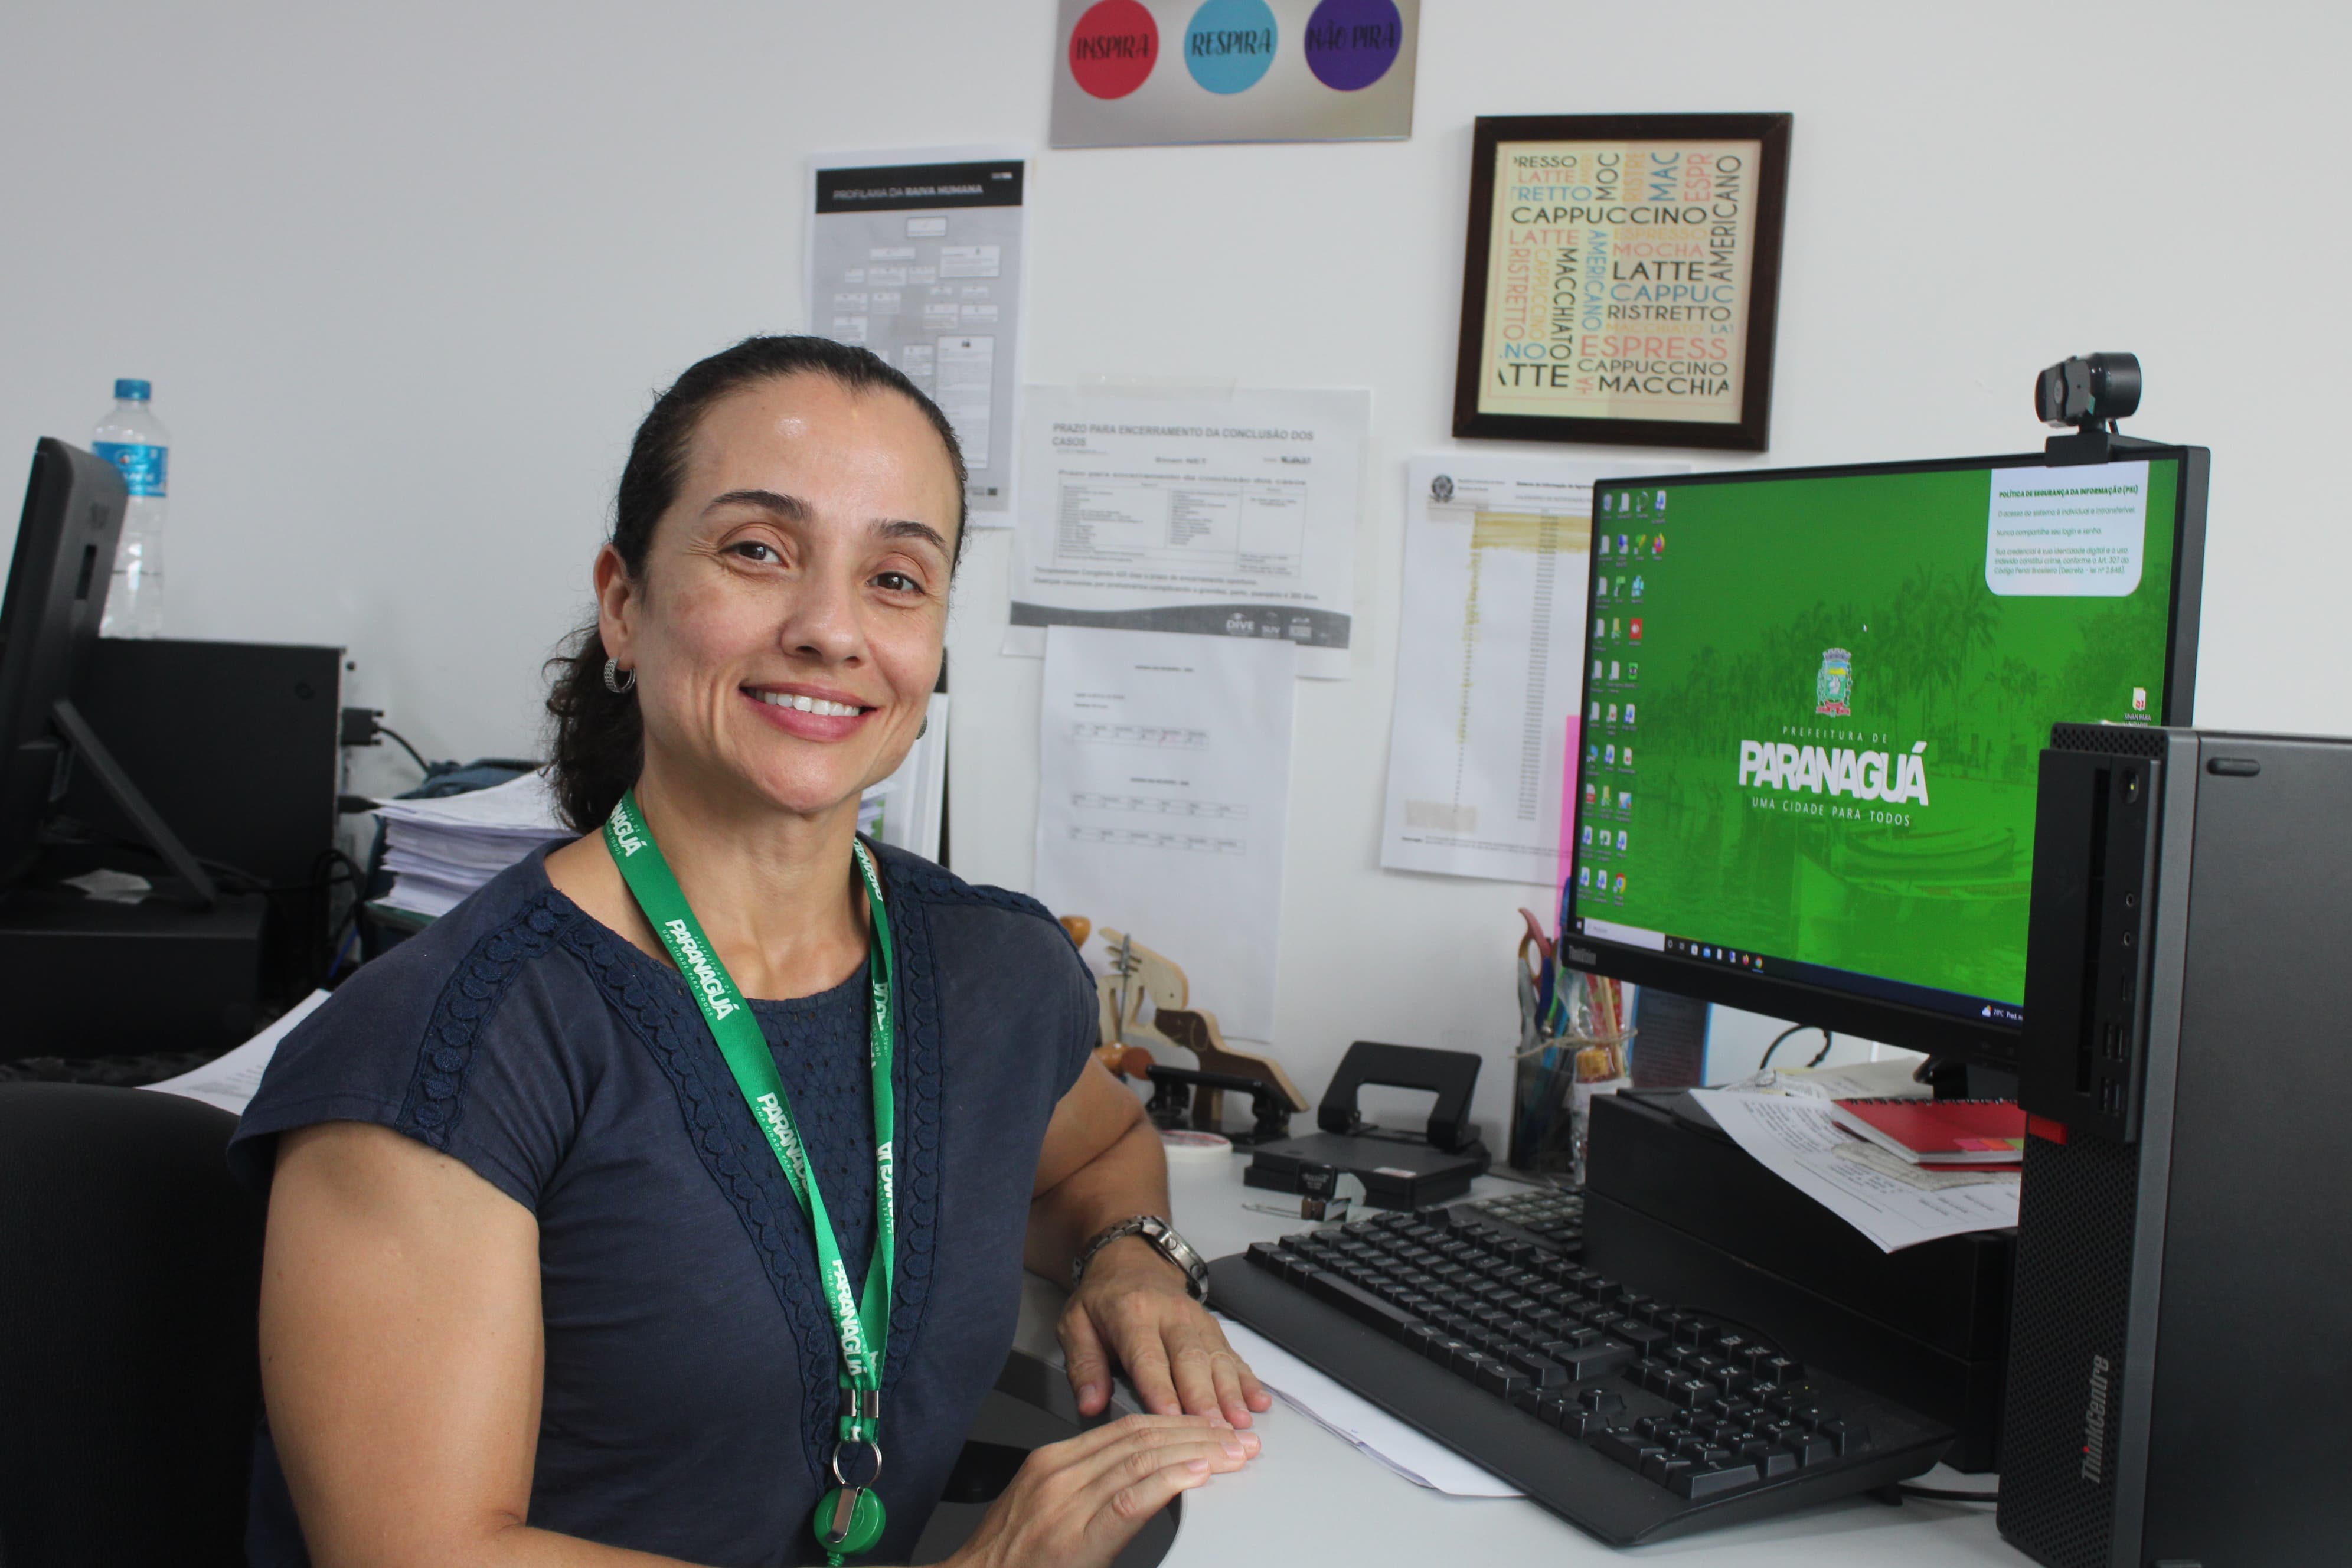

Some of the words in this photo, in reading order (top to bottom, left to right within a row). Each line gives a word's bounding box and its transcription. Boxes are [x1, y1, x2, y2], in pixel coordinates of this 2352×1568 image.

[1076, 34, 1150, 60] INSPIRA
[1191, 28, 1272, 57] RESPIRA
[1308, 19, 1347, 51] NÃO
[1351, 24, 1396, 49] PIRA
[1518, 169, 1576, 184] LATTE
[1595, 152, 1620, 201] MOC
[1648, 152, 1680, 201] MAC
[1684, 153, 1713, 202] ESPR
[1511, 206, 1707, 224] CAPPUCCINO
[1708, 155, 1742, 282] AMERICANO
[1509, 228, 1580, 246] LATTE
[1614, 227, 1709, 240] ESPRESSO
[1613, 242, 1704, 257] MOCHA
[1582, 228, 1608, 331] AMERICANO
[1613, 260, 1705, 281] LATTE
[1502, 248, 1531, 341] RISTRETTO
[1550, 247, 1579, 360] MACCHIATO
[1610, 283, 1735, 303] CAPPUC
[1608, 304, 1732, 322] RISTRETTO
[1500, 342, 1547, 360] NO
[1580, 335, 1728, 360] ESPRESS
[1577, 358, 1728, 376] CAPPUCCINO
[1599, 375, 1729, 396] MACCHIA
[1052, 436, 1086, 446] CASOS
[1053, 423, 1087, 433] PRAZO
[1090, 424, 1116, 434] PARA
[1119, 424, 1203, 437] ENCERRAMENTO
[1206, 428, 1220, 437] DA
[1223, 427, 1288, 440] CONCLUSÃO
[1291, 430, 1314, 440] DOS
[1782, 725, 1863, 741] PREFEITURA
[1872, 733, 1887, 744] DE
[1739, 739, 1929, 806] PARANAGUÁ
[1752, 796, 1776, 810] UMA
[1782, 799, 1825, 816] CIDADE
[1832, 806, 1861, 821] PARA
[1870, 810, 1910, 827] TODOS
[662, 930, 674, 944] UMA
[672, 946, 690, 969] CIDADE
[688, 972, 700, 990] PARA
[699, 992, 713, 1017] TODOS
[665, 919, 740, 1021] PARANAGUÁ
[754, 1106, 766, 1122] UMA
[765, 1125, 782, 1152] CIDADE
[781, 1155, 793, 1174] PARA
[832, 1259, 868, 1376] PARANAGUÁ
[2081, 1354, 2109, 1484] ThinkCentre
